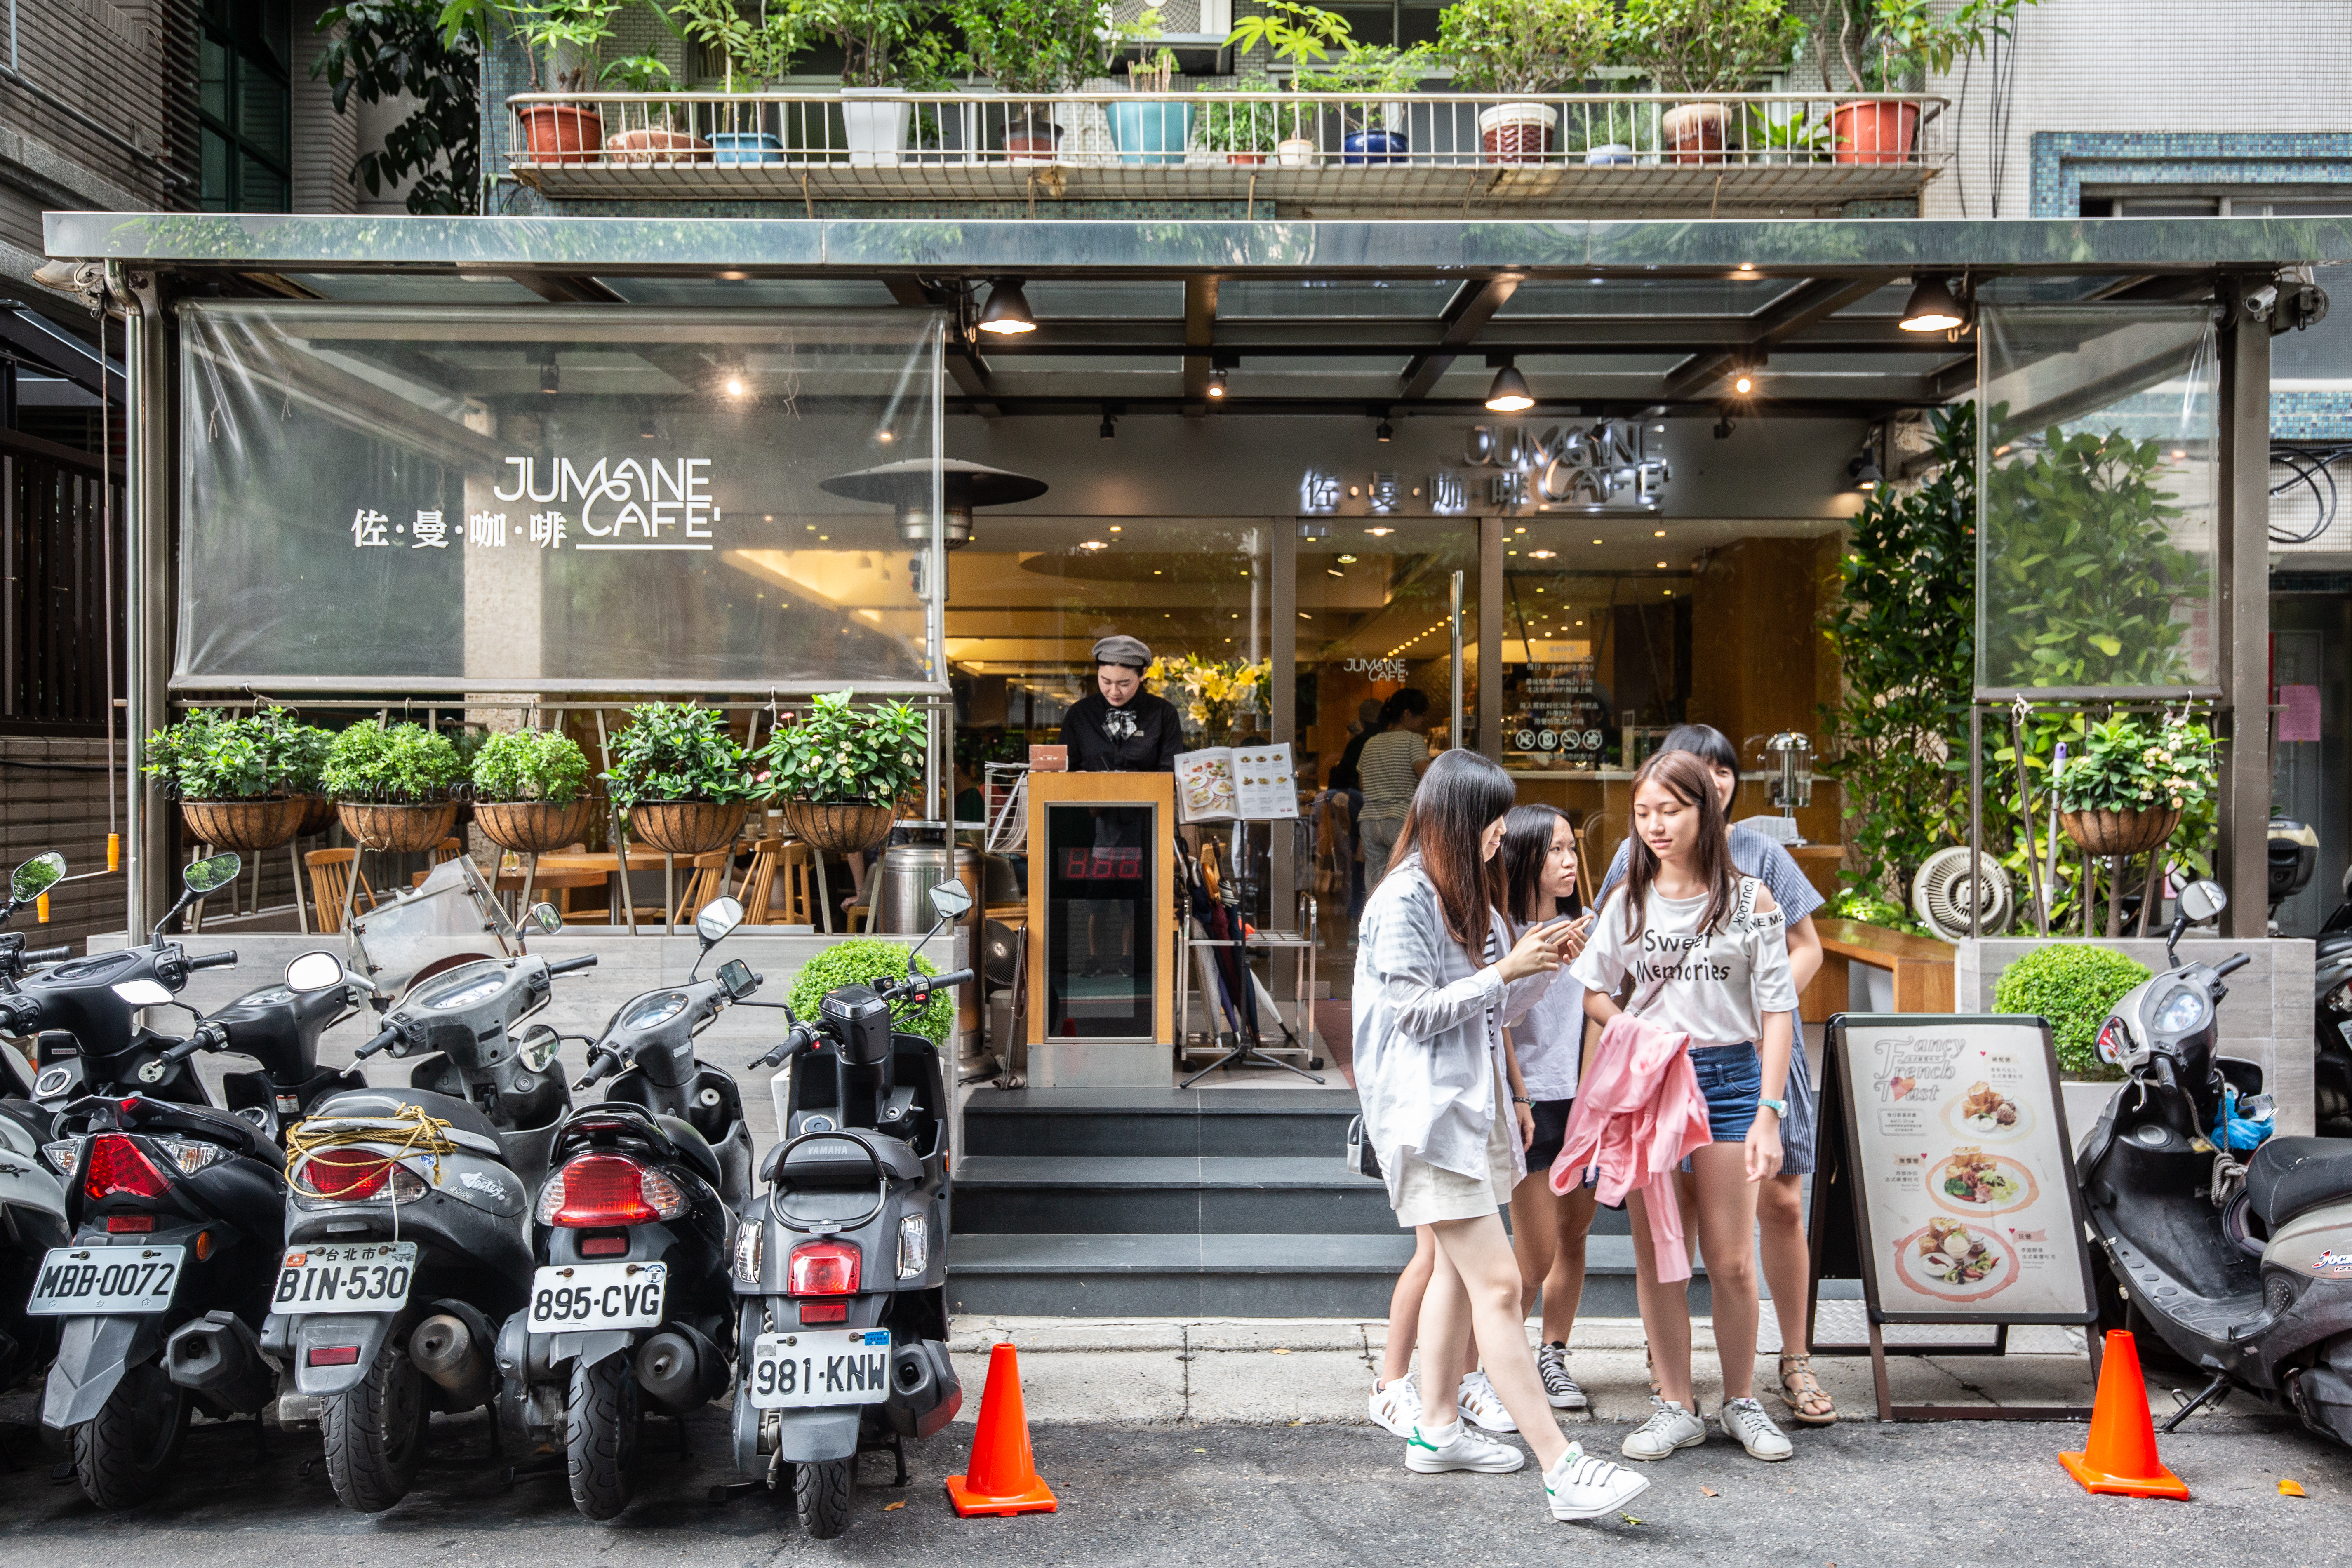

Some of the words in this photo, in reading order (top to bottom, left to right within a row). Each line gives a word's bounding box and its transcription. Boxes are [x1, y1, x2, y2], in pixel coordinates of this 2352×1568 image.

[1743, 880, 1756, 898] YOU
[1733, 900, 1750, 926] LOOK
[1769, 912, 1784, 926] ME
[1644, 929, 1713, 952] Sweet
[1637, 957, 1731, 984] Memories
[808, 1146, 848, 1155] YAMAHA
[326, 1247, 376, 1262] 台北市
